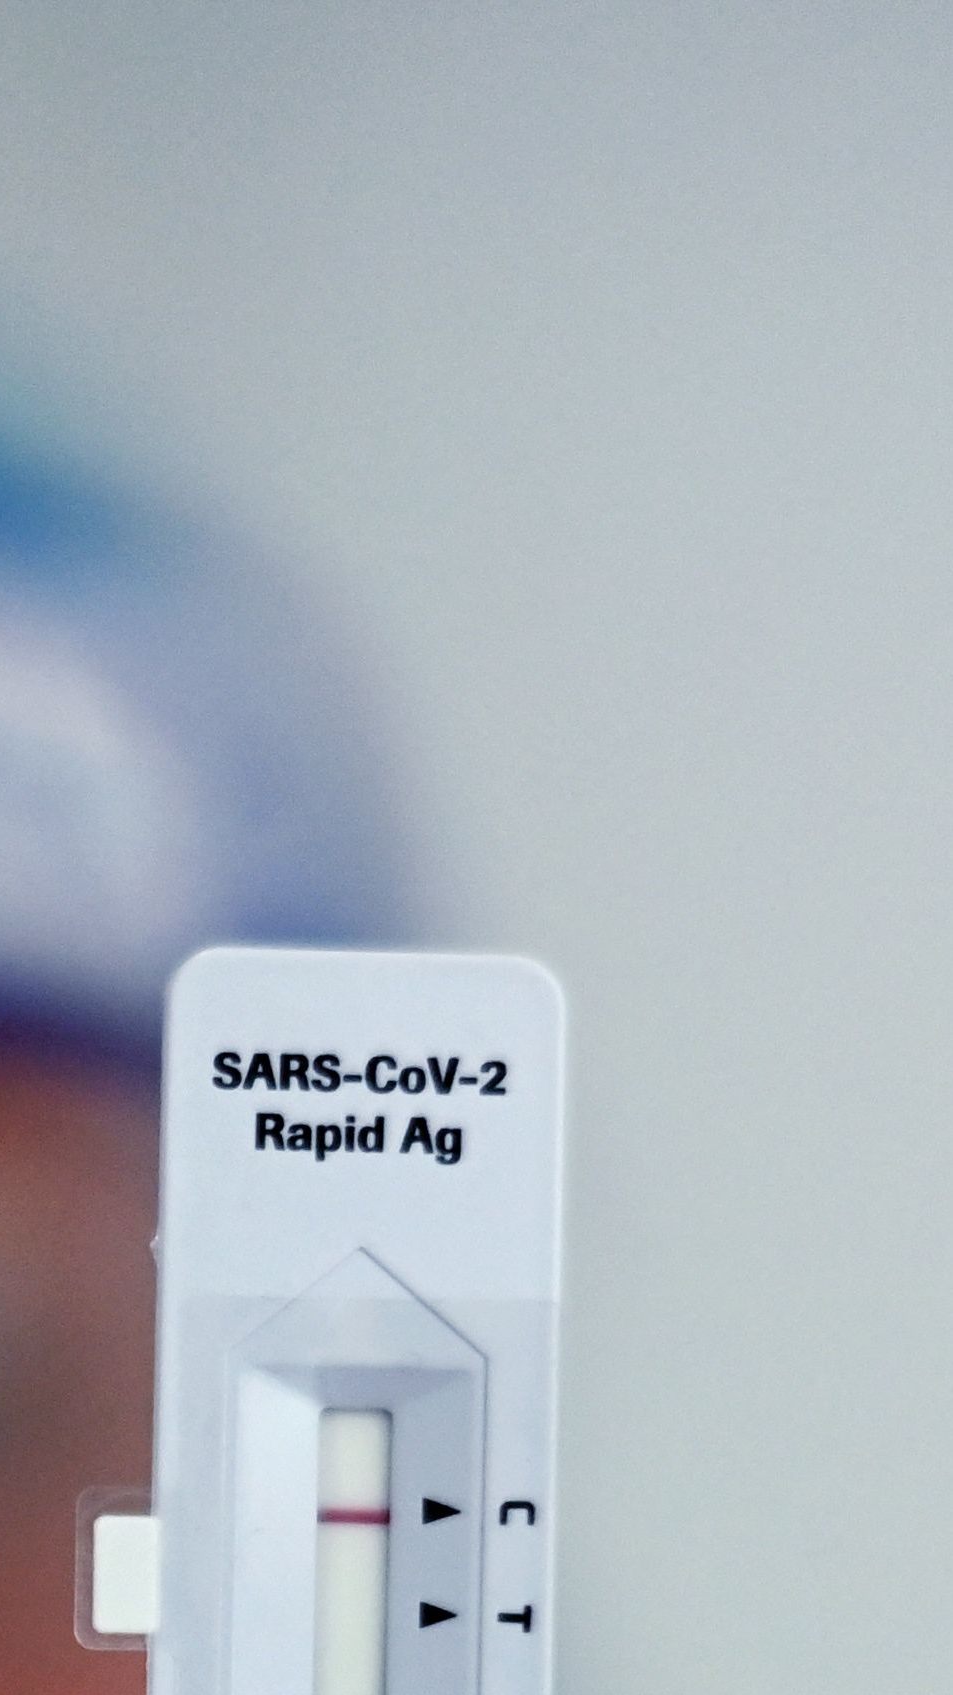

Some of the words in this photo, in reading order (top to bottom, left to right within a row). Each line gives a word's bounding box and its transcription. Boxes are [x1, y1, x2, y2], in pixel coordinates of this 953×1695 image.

[211, 1050, 509, 1096] SARS-CoV-2
[254, 1111, 387, 1163] Rapid
[399, 1115, 464, 1166] Ag
[498, 1499, 537, 1527] C
[496, 1603, 534, 1634] T
